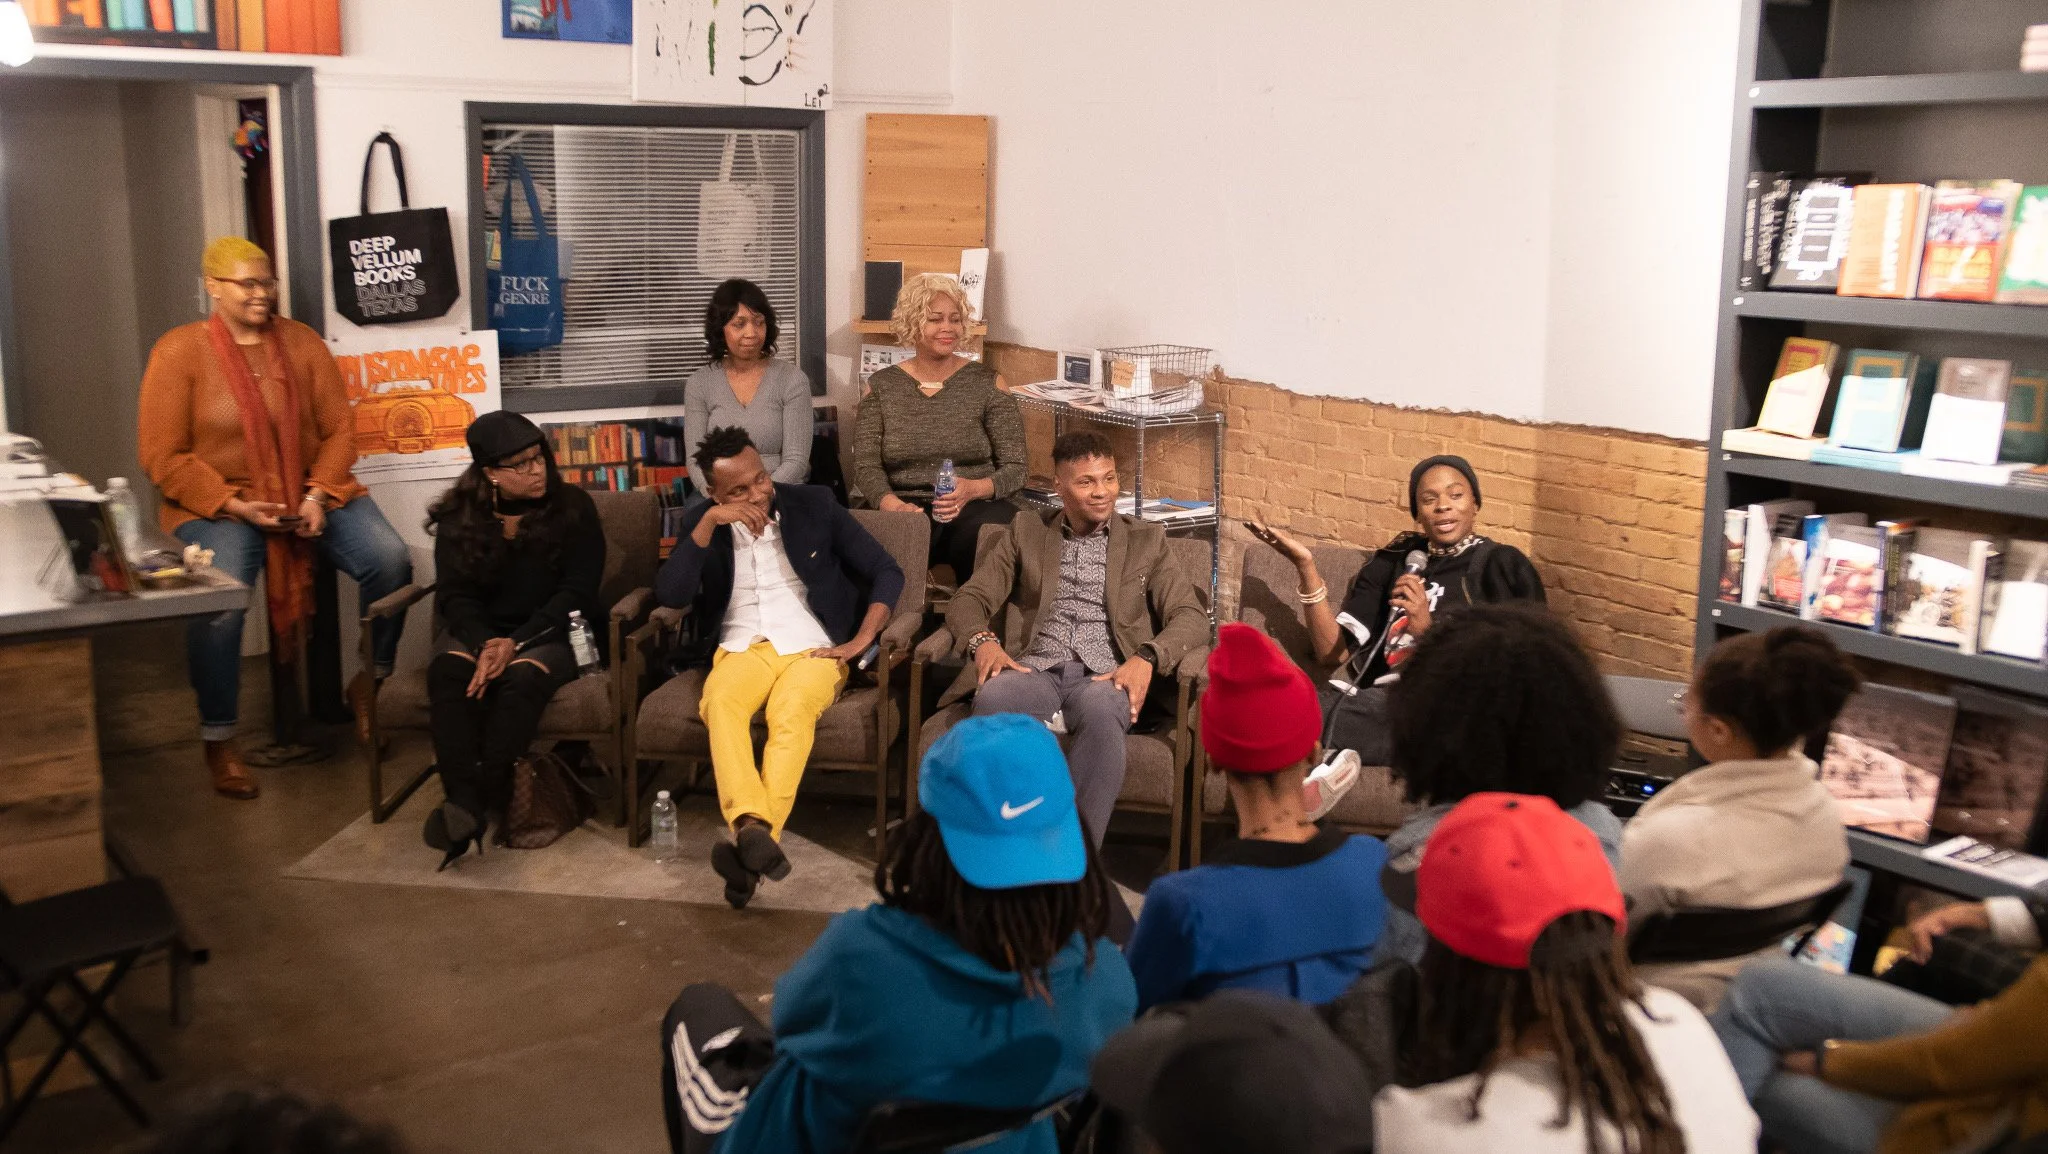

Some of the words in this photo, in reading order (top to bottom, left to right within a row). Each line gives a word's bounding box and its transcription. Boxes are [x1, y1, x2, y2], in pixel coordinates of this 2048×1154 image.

[349, 236, 396, 255] DEEP
[350, 248, 422, 270] VELLUM
[353, 265, 416, 286] BOOKS
[500, 276, 550, 291] FUCK
[356, 279, 427, 301] DALLAS
[500, 292, 550, 304] GENRE
[357, 296, 419, 317] TEXAS
